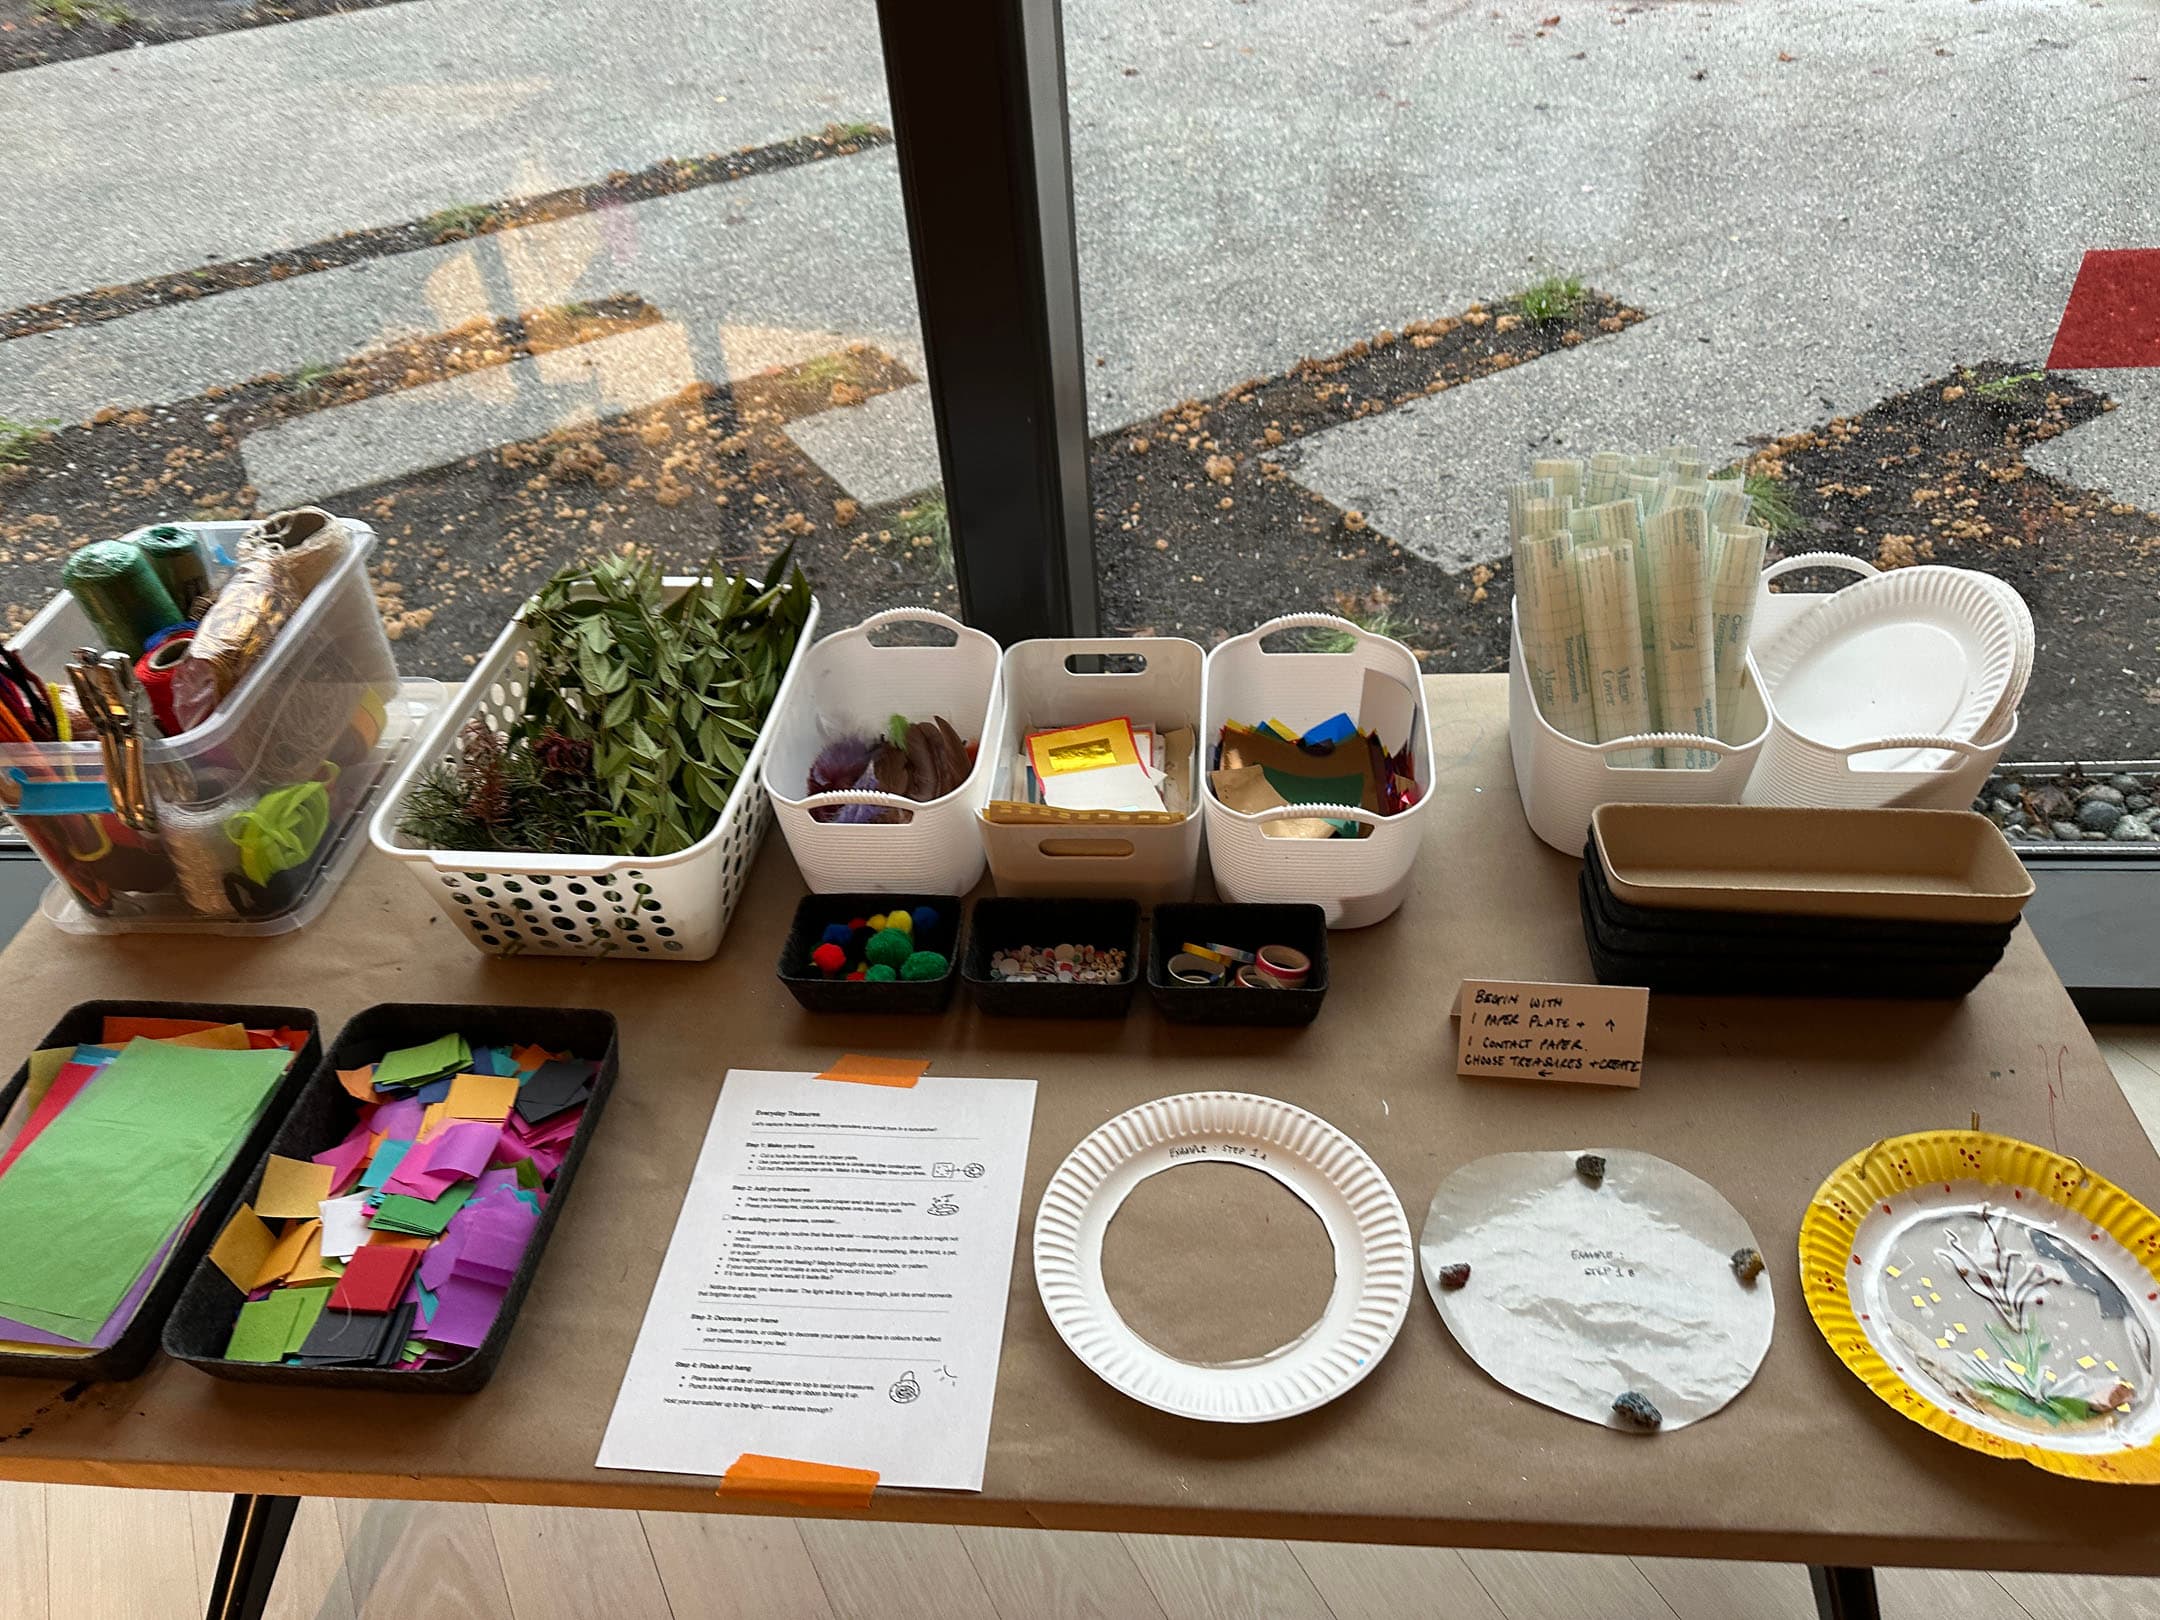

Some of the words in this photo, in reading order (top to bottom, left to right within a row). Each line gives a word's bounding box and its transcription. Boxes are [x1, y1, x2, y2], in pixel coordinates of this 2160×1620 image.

[1475, 989, 1519, 1005] BEGIN
[1530, 998, 1563, 1009] WITH
[1484, 1014, 1519, 1026] PAPER
[1529, 1015, 1570, 1028] PLATE
[1483, 1037, 1532, 1049] CONTACT
[1464, 1055, 1505, 1066] CHOOSE
[1510, 1056, 1583, 1070] TREASURES
